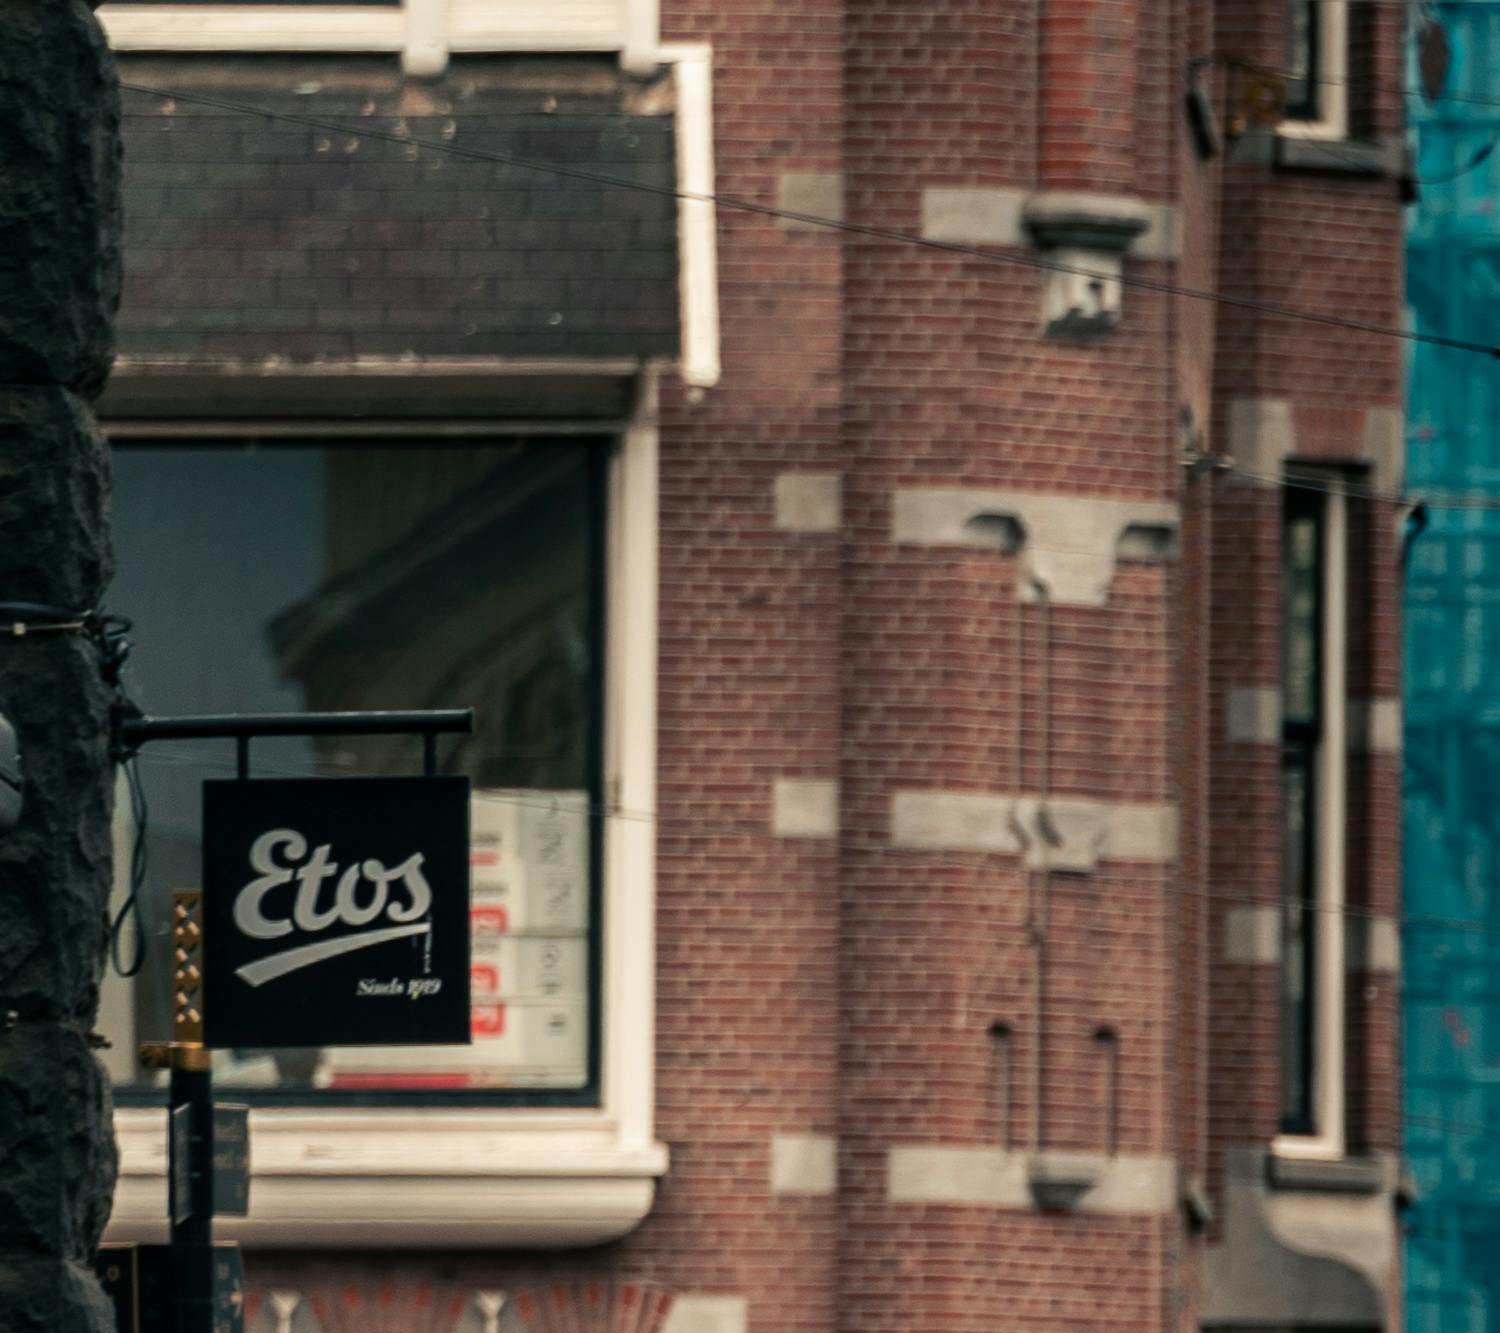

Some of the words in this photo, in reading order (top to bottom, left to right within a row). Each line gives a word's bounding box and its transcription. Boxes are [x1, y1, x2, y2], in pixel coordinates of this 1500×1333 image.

[233, 828, 432, 939] Etos
[356, 979, 404, 996] Sinds
[407, 978, 442, 999] 1919
